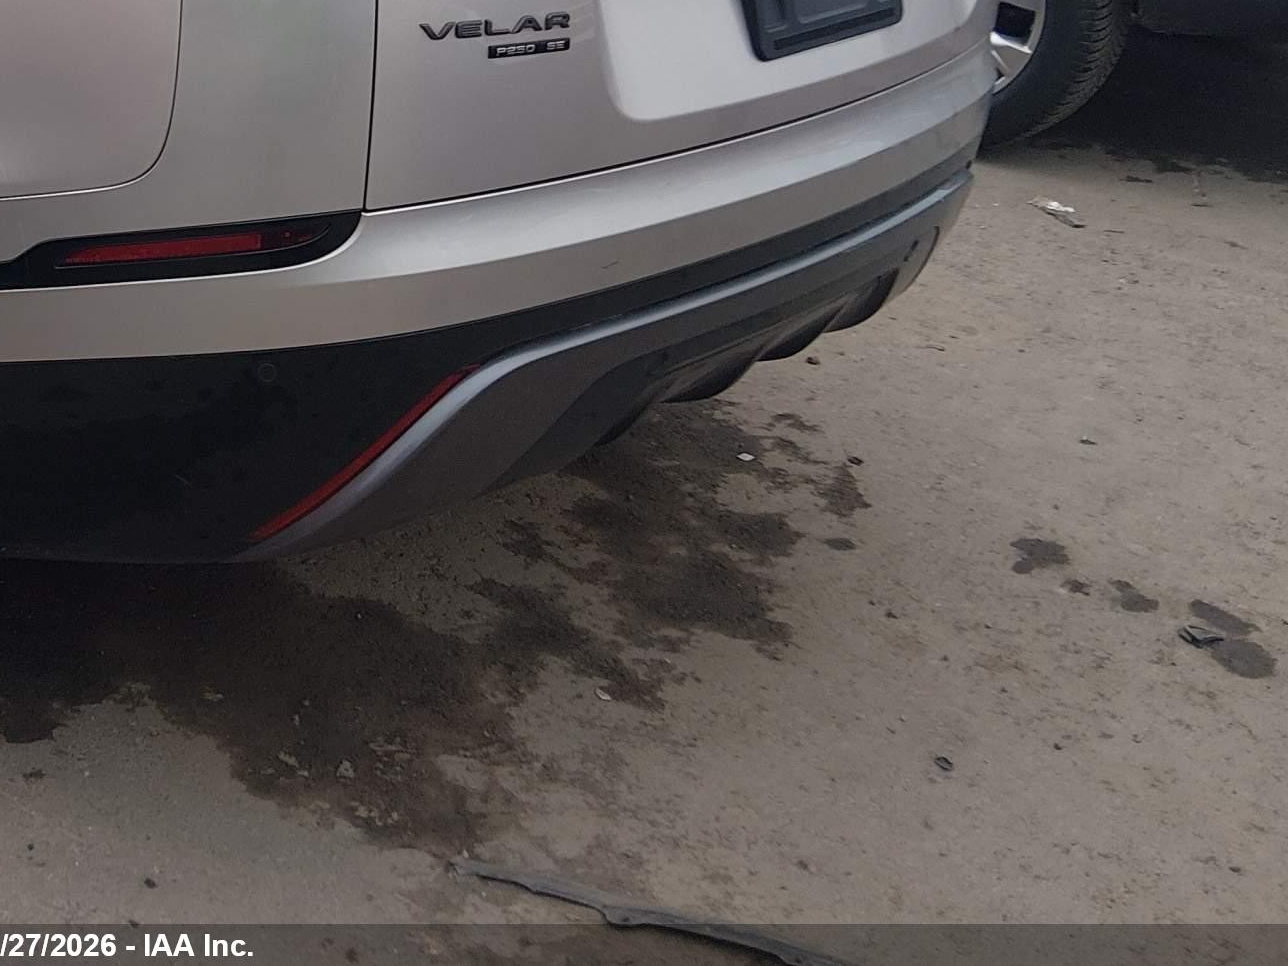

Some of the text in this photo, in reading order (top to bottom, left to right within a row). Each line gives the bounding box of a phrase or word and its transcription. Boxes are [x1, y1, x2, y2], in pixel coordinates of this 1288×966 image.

[418, 11, 571, 41] VELAR
[496, 40, 565, 58] P250 SE
